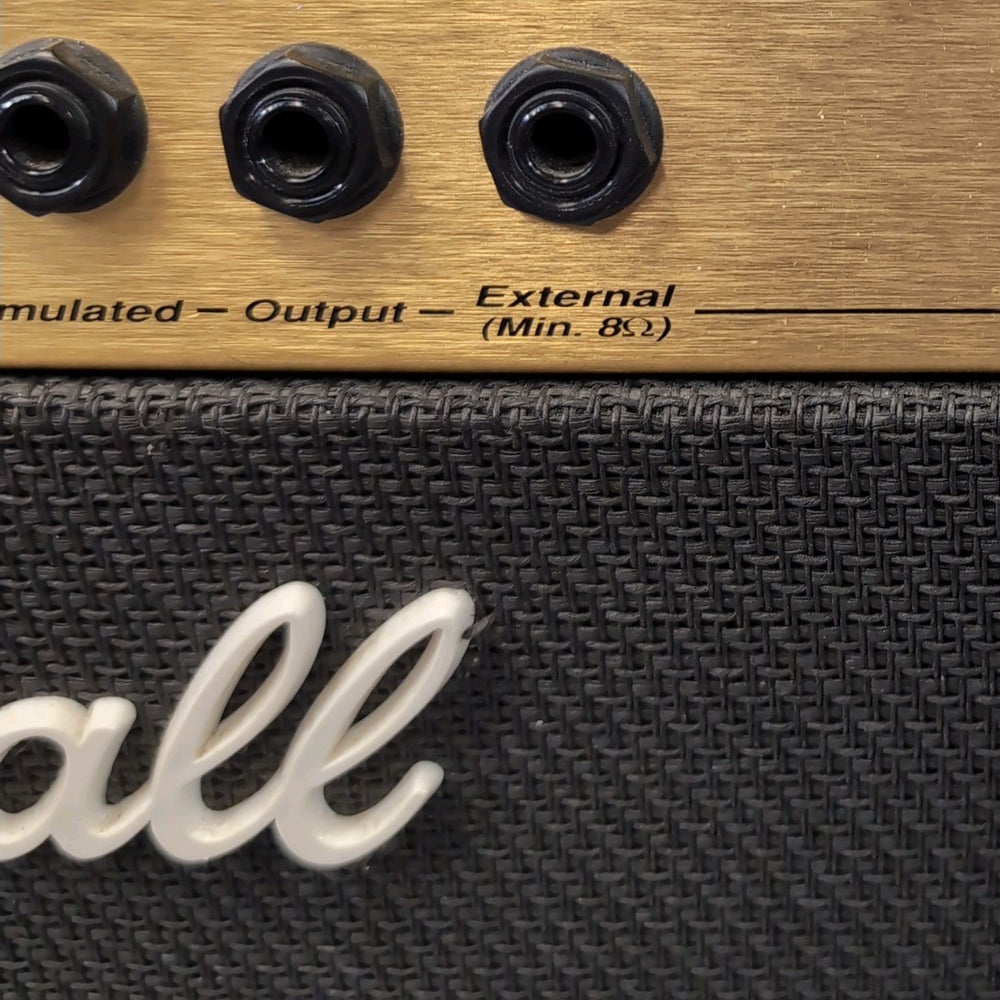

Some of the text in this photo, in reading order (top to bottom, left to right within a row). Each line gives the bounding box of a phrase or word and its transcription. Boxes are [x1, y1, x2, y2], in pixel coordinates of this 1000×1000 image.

[476, 284, 676, 309] External
[244, 299, 408, 327] Output
[482, 316, 582, 341] (Min.
